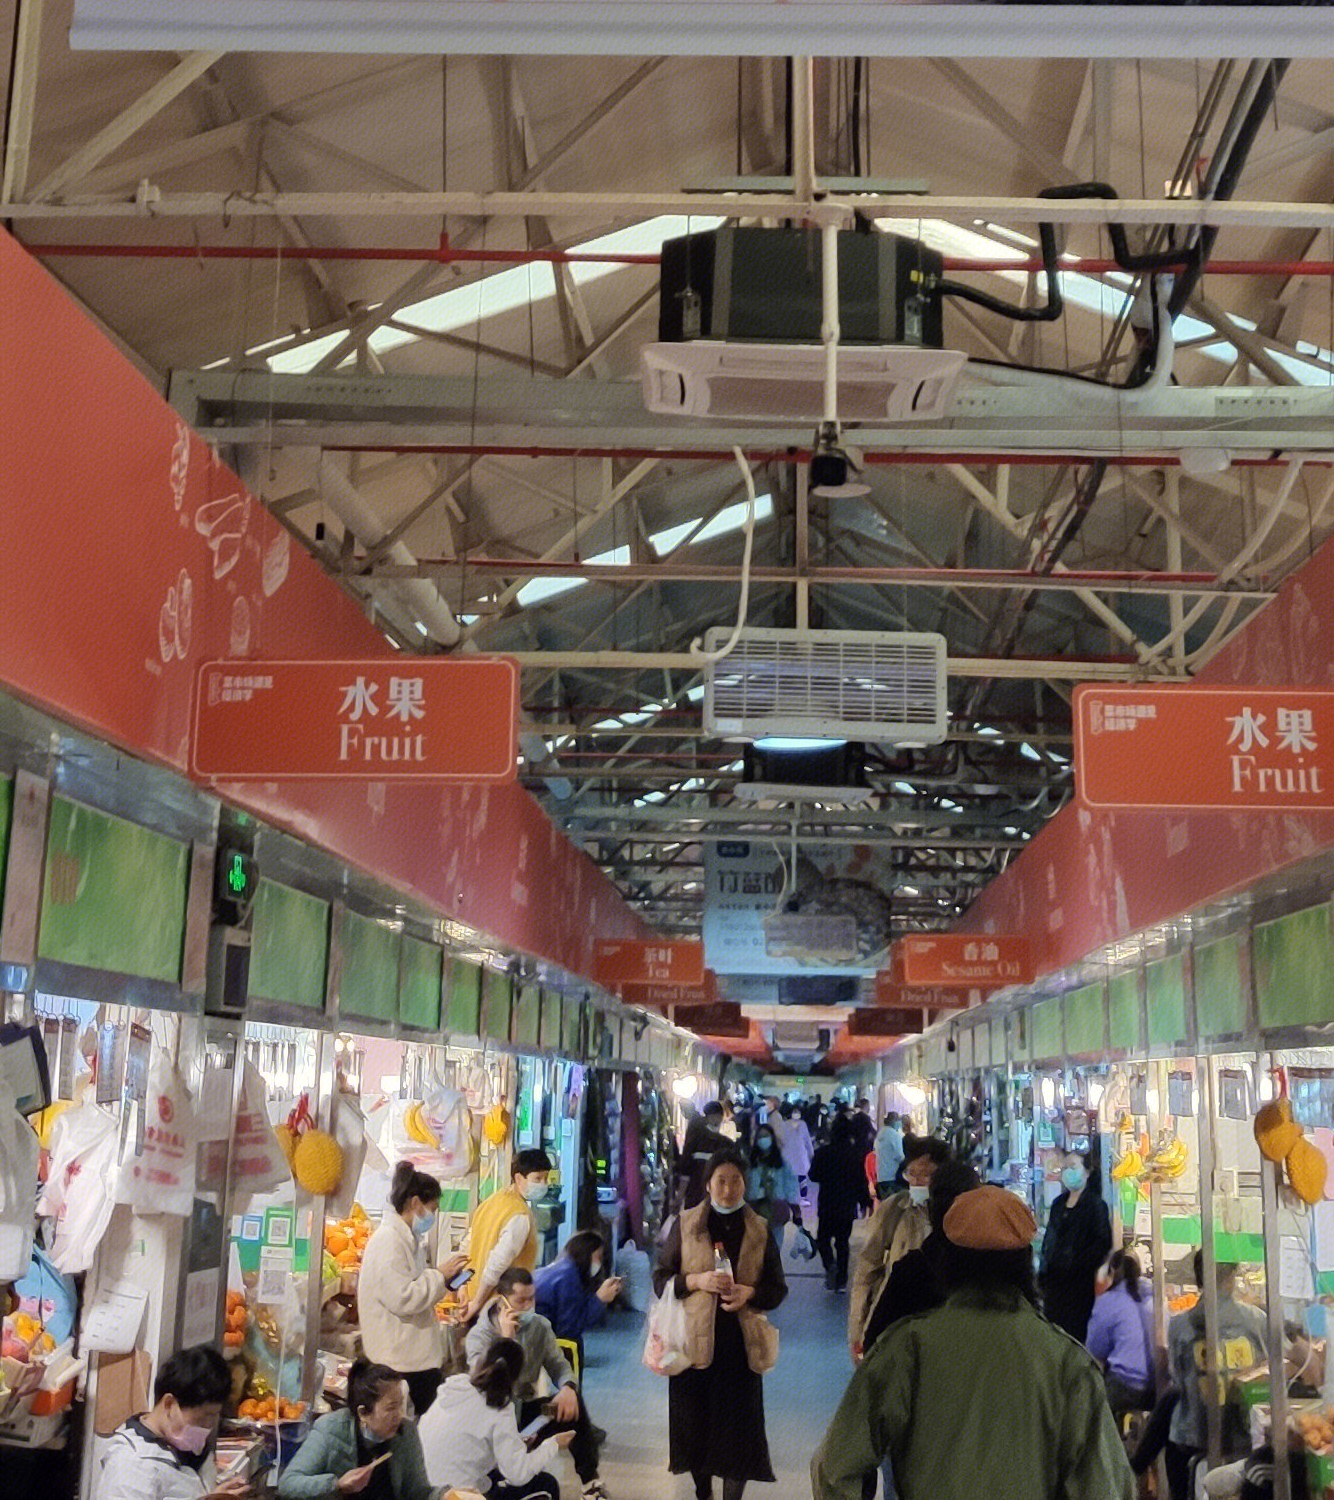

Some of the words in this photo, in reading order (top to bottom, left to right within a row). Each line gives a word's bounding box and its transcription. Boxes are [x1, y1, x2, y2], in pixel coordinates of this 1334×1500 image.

[336, 676, 427, 722] 水果
[338, 723, 428, 762] Fruit
[1225, 706, 1319, 754] 水果
[1229, 754, 1325, 794] Fruit
[647, 964, 670, 979] Tea
[941, 960, 993, 978] Sesame
[997, 959, 1021, 978] Oil
